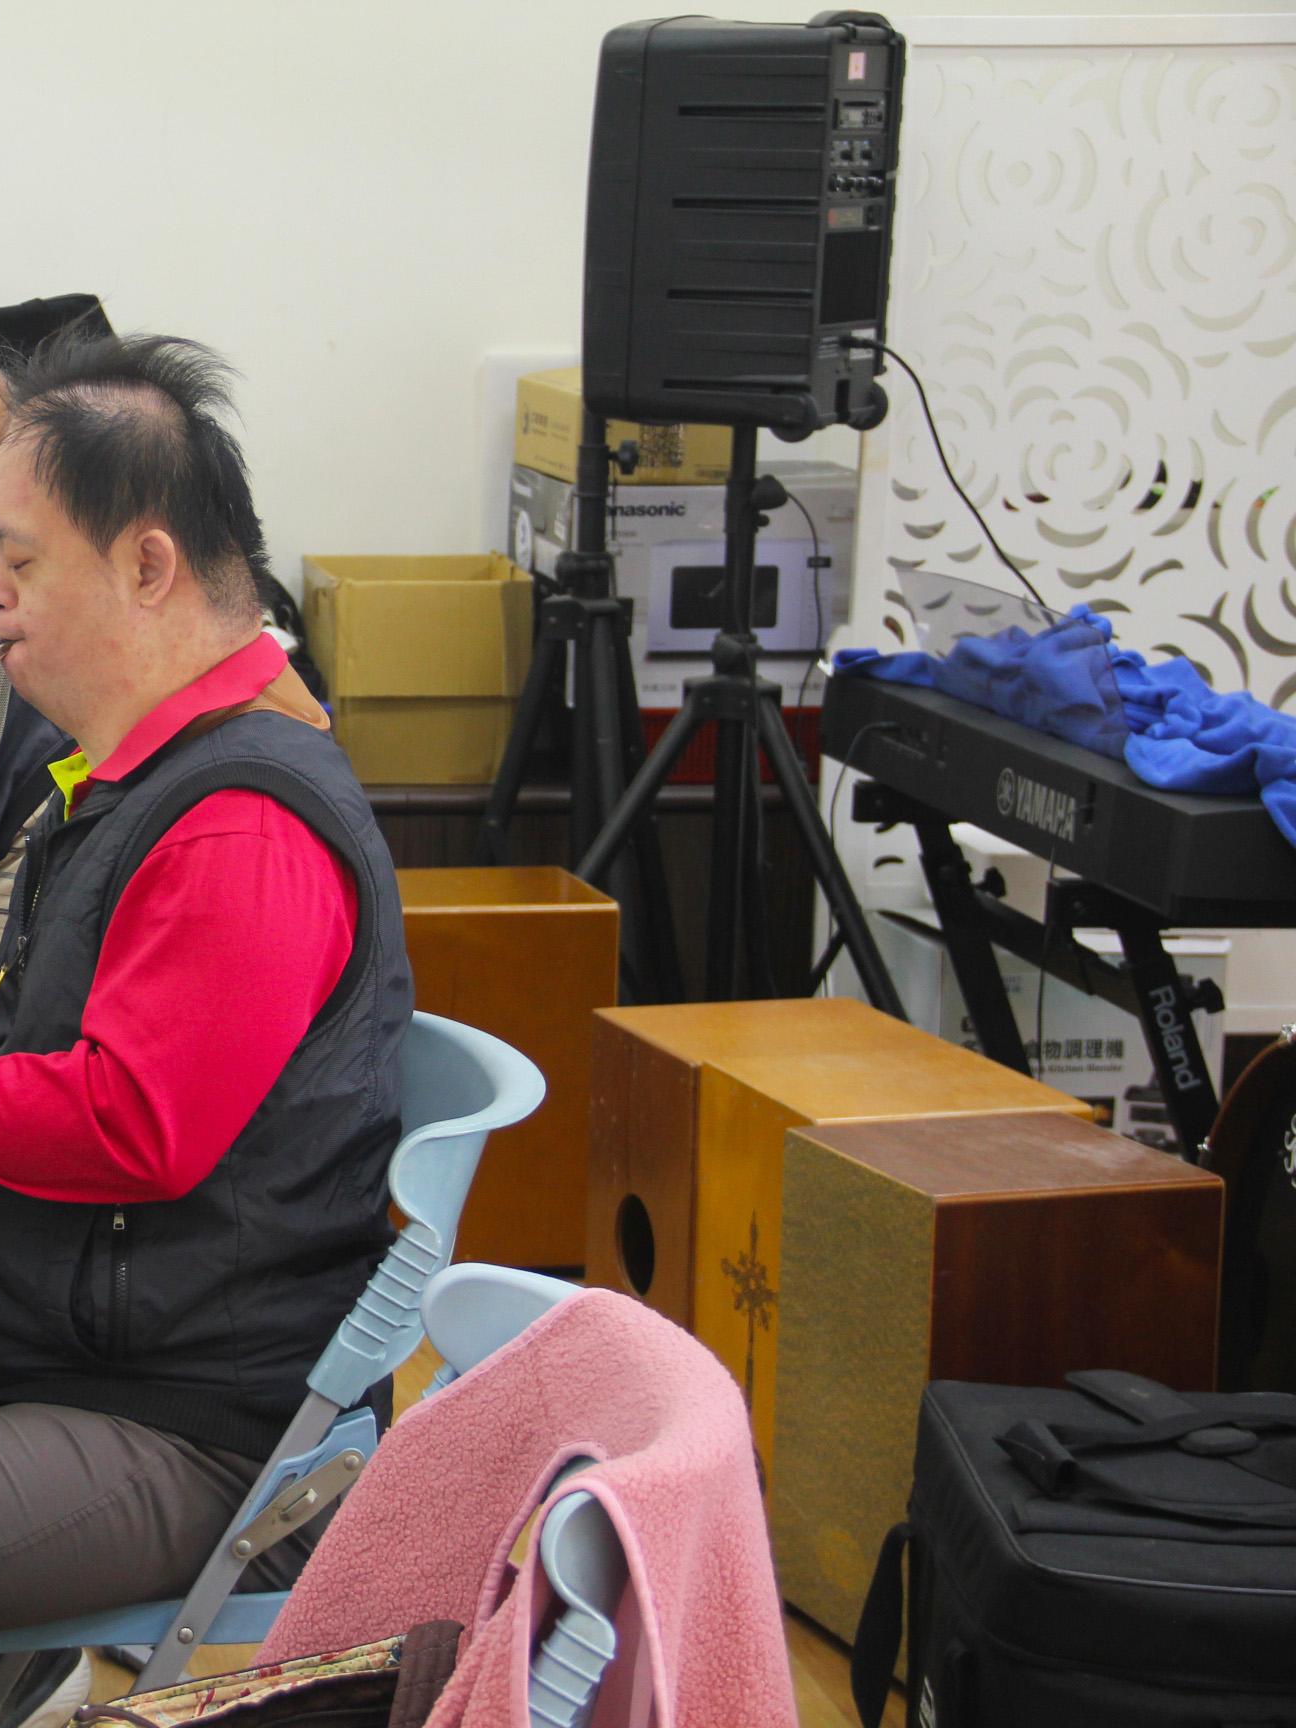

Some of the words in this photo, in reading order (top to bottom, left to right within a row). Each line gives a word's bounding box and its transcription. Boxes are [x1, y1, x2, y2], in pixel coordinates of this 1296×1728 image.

[604, 501, 687, 517] anasonic
[1016, 775, 1075, 842] YAMAHA
[1149, 985, 1201, 1091] Roland
